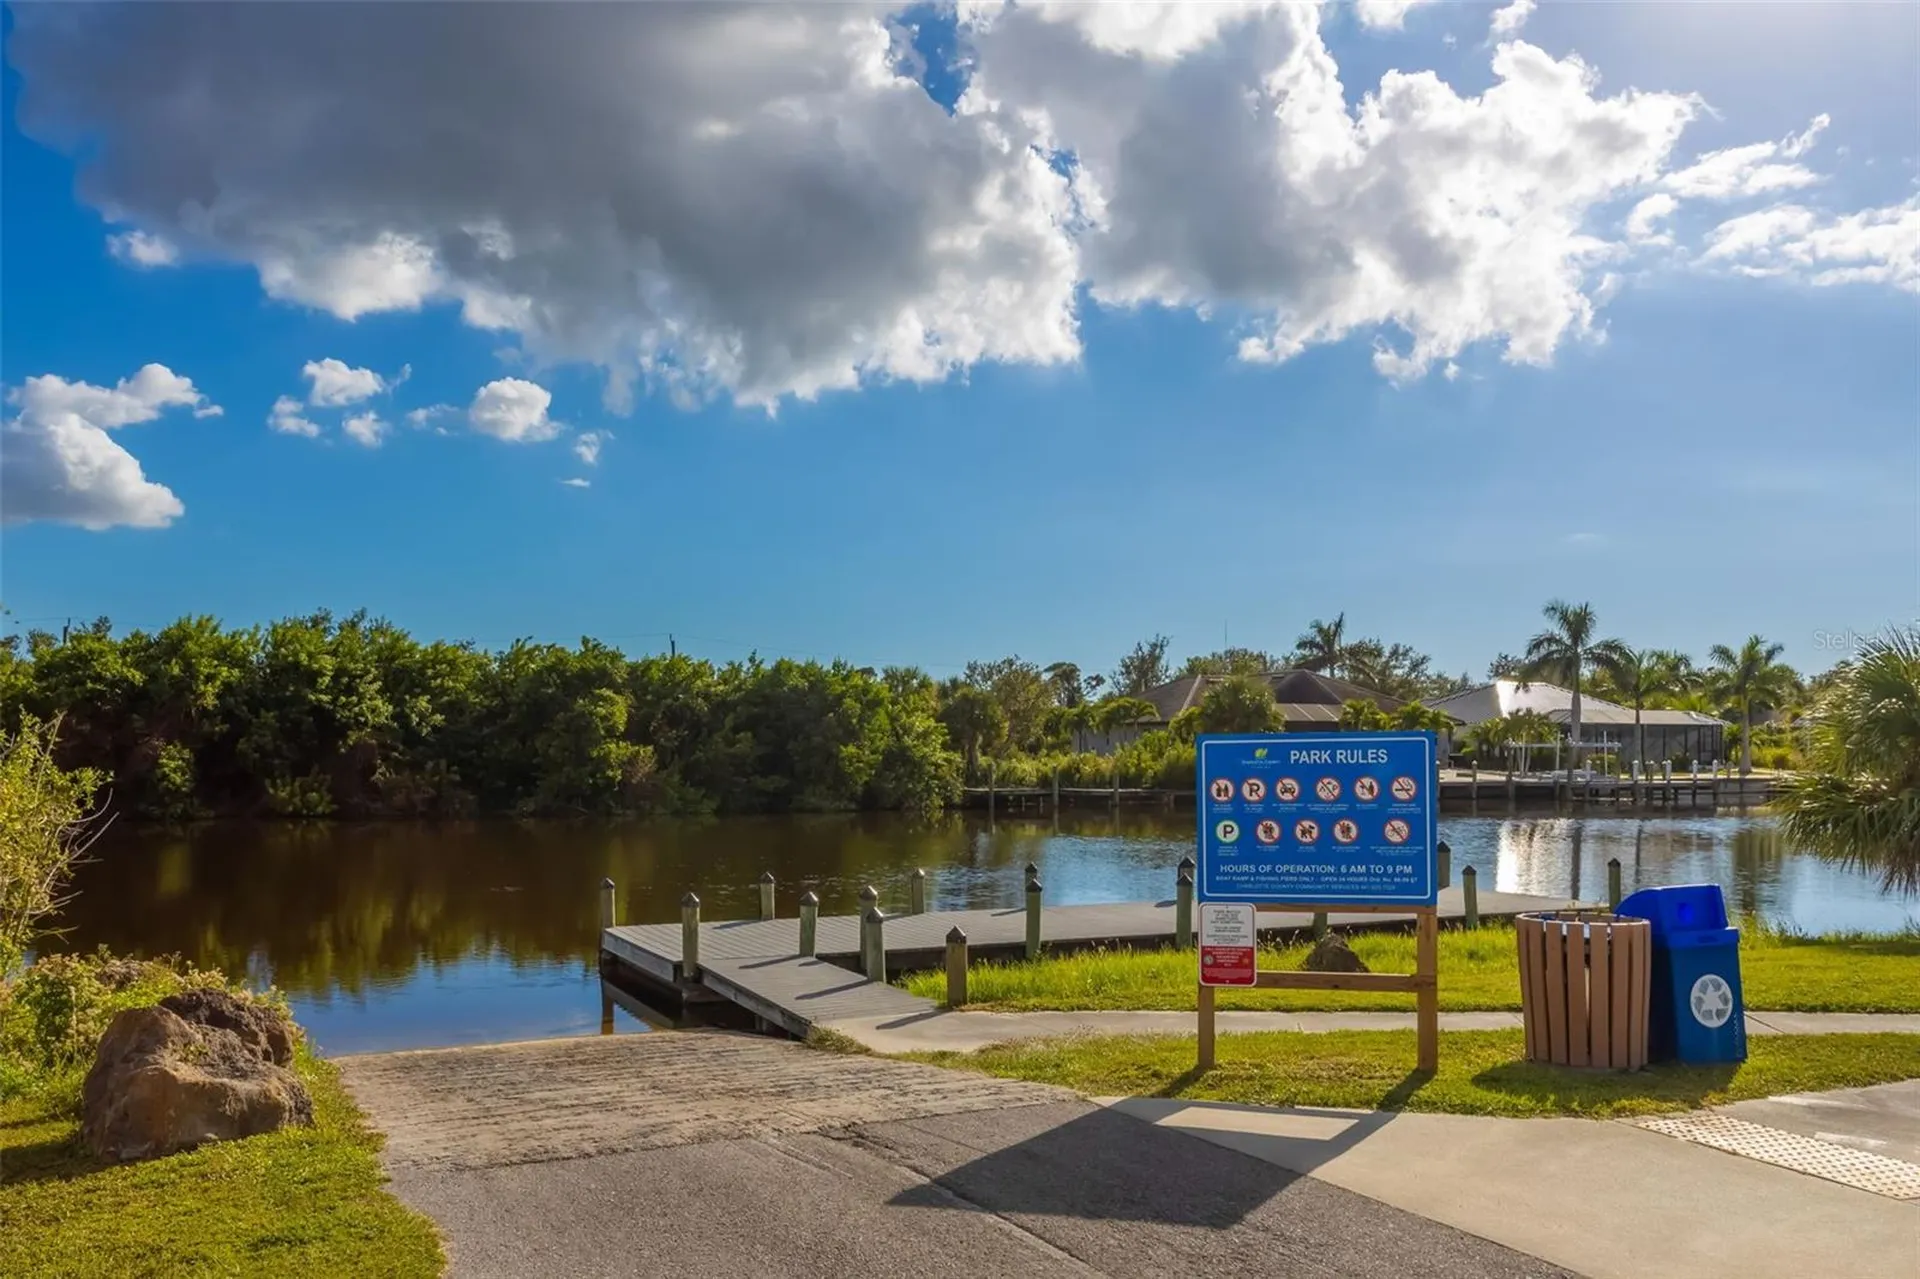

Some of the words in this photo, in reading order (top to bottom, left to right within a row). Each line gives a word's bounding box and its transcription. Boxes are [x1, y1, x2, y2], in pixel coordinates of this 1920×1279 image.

[1290, 750, 1332, 764] PARK
[1336, 749, 1388, 763] RULES
[1223, 824, 1234, 838] P
[1220, 864, 1256, 873] HOURS
[1258, 864, 1272, 873] OF
[1340, 865, 1347, 873] 6
[1349, 865, 1366, 873] AM
[1370, 865, 1384, 873] TO
[1386, 865, 1393, 873] 9
[1395, 865, 1412, 873] PM
